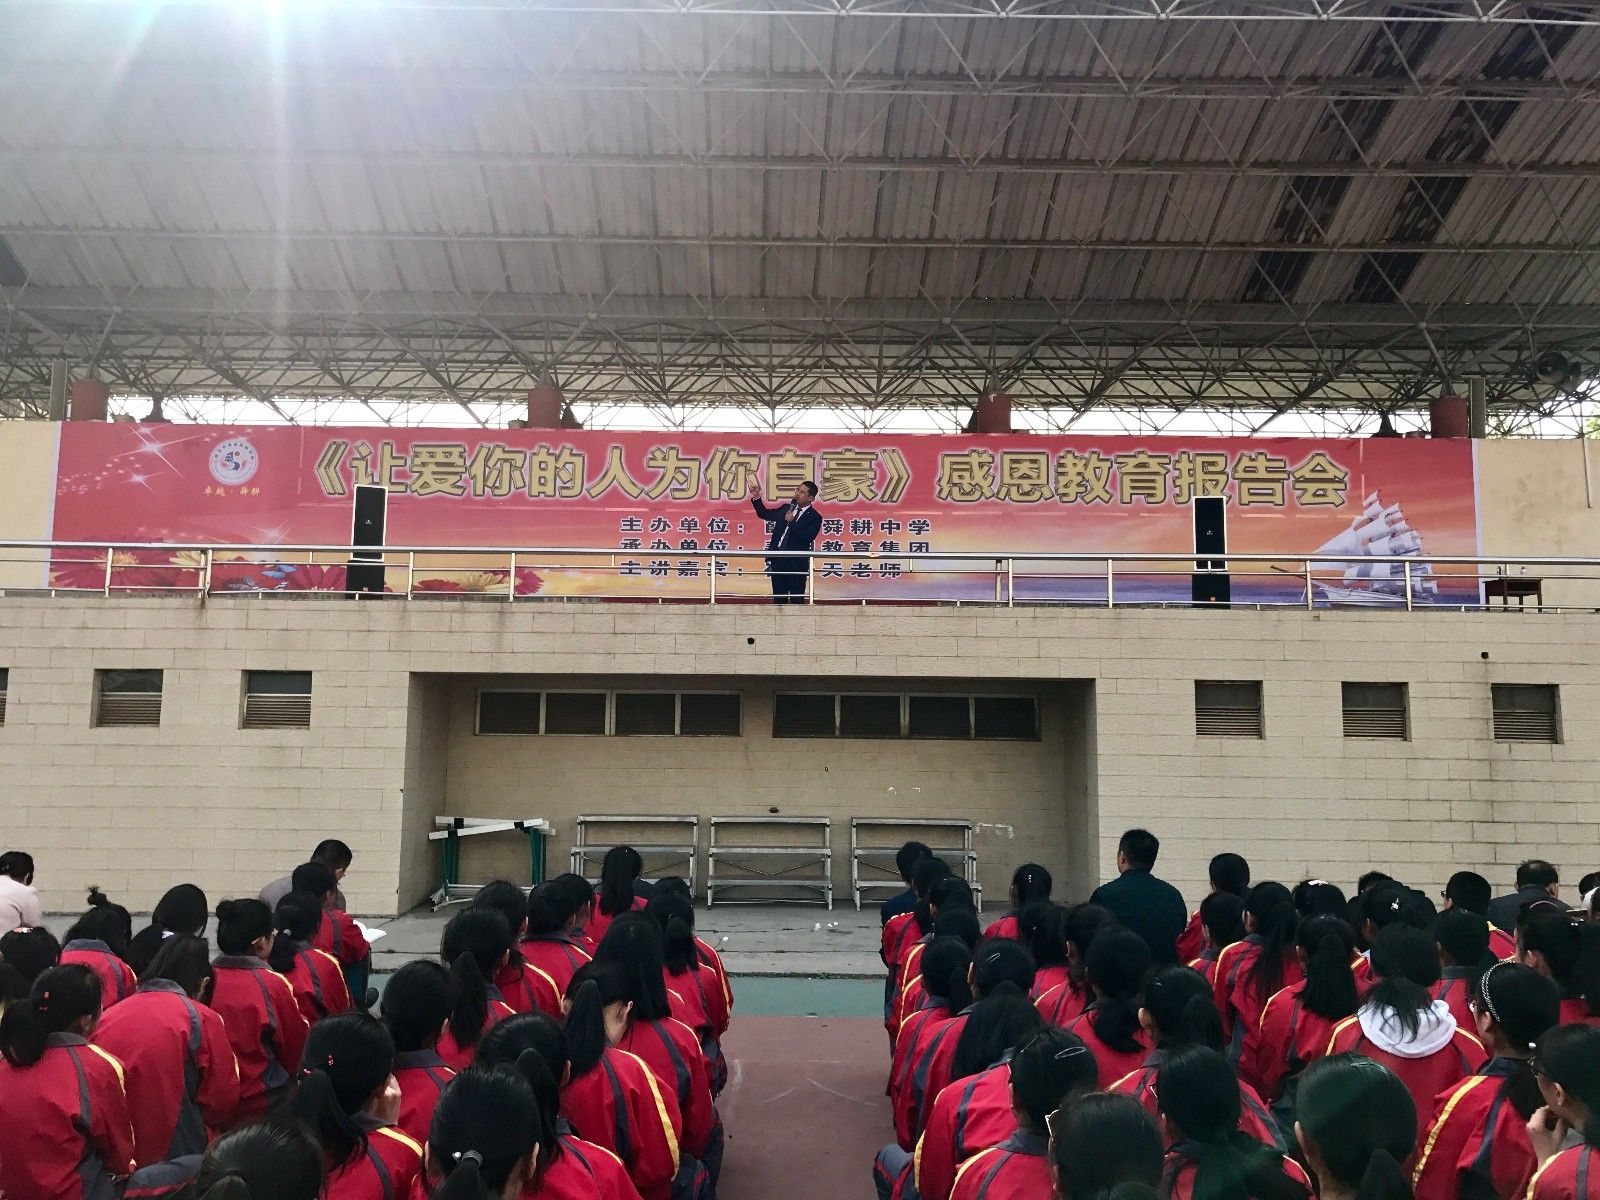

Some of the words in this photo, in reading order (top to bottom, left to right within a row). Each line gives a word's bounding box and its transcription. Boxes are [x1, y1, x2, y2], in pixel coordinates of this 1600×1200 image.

[315, 440, 911, 503] 《让爱你的人为你自豪》
[937, 450, 1350, 507] 感恩教育报告会
